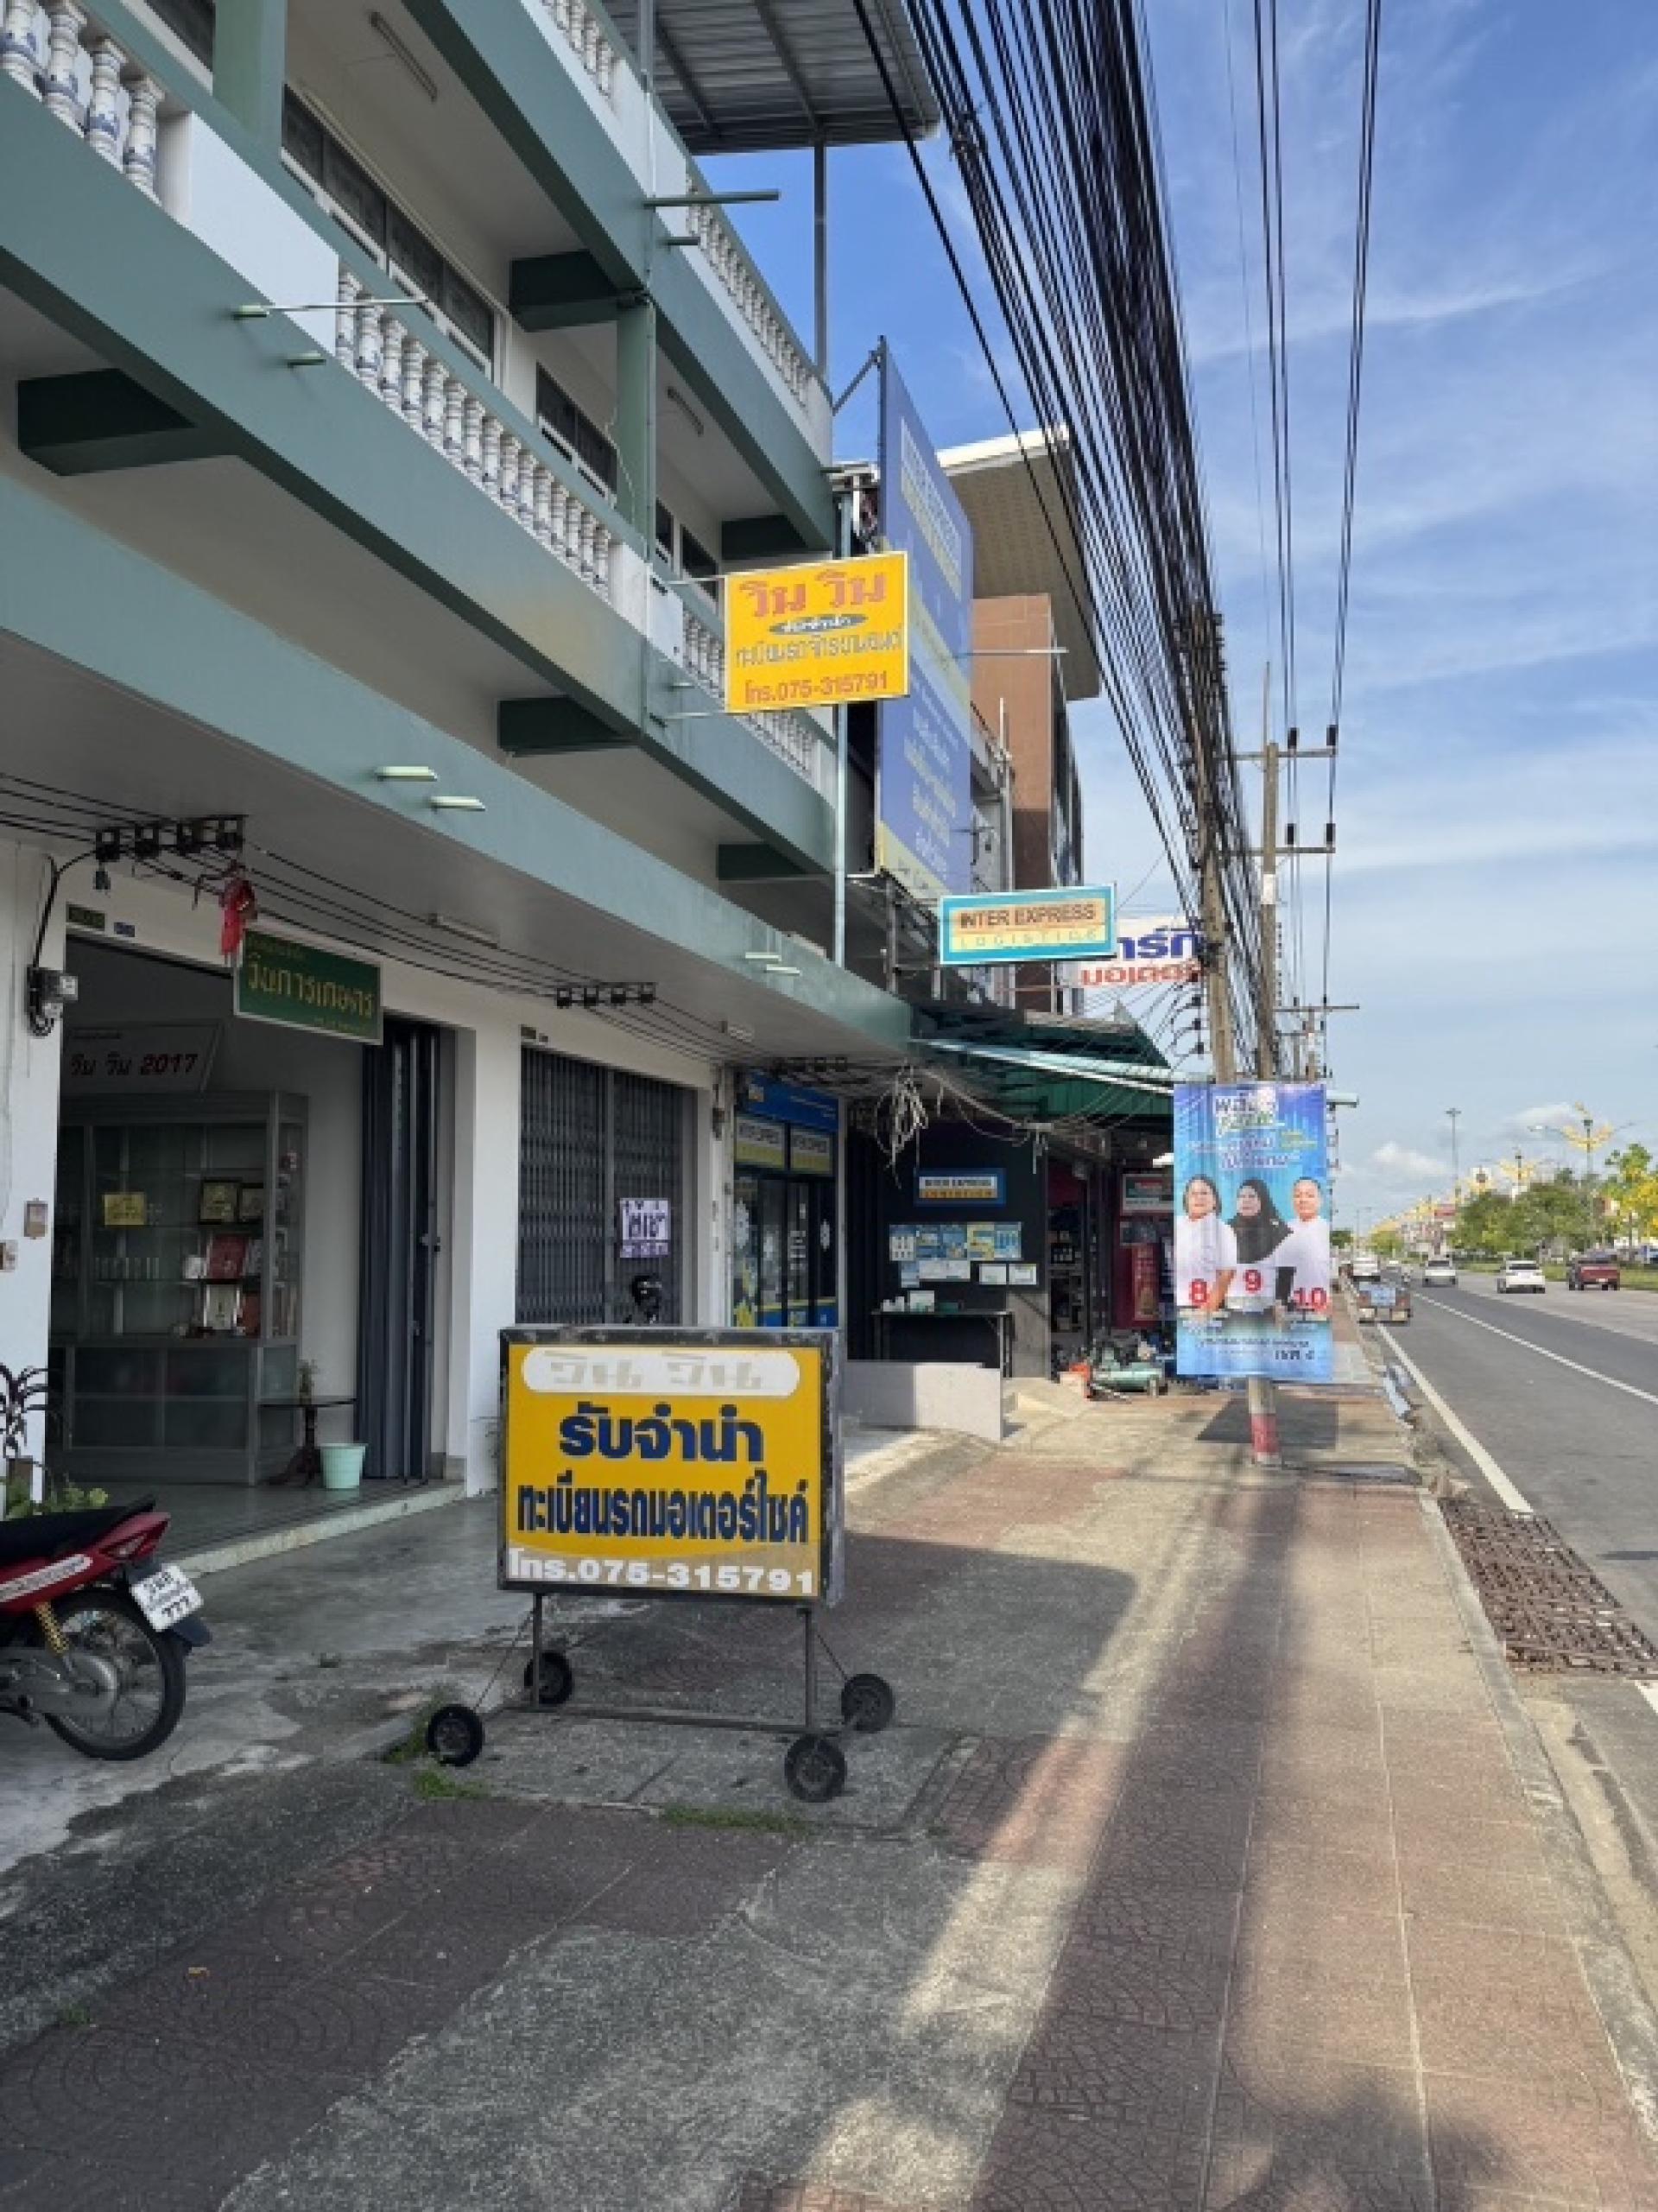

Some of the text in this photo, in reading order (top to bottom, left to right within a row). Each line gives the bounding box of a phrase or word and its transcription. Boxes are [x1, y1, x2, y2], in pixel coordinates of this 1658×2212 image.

[960, 903, 1096, 929] INTER EXPRESS
[139, 1052, 199, 1076] 2017
[1189, 1278, 1210, 1304] 8
[1244, 1268, 1262, 1293] 9
[1294, 1286, 1328, 1311] 10
[560, 1400, 764, 1463] รับจำนำ
[507, 1546, 813, 1594] โทร.075-315791
